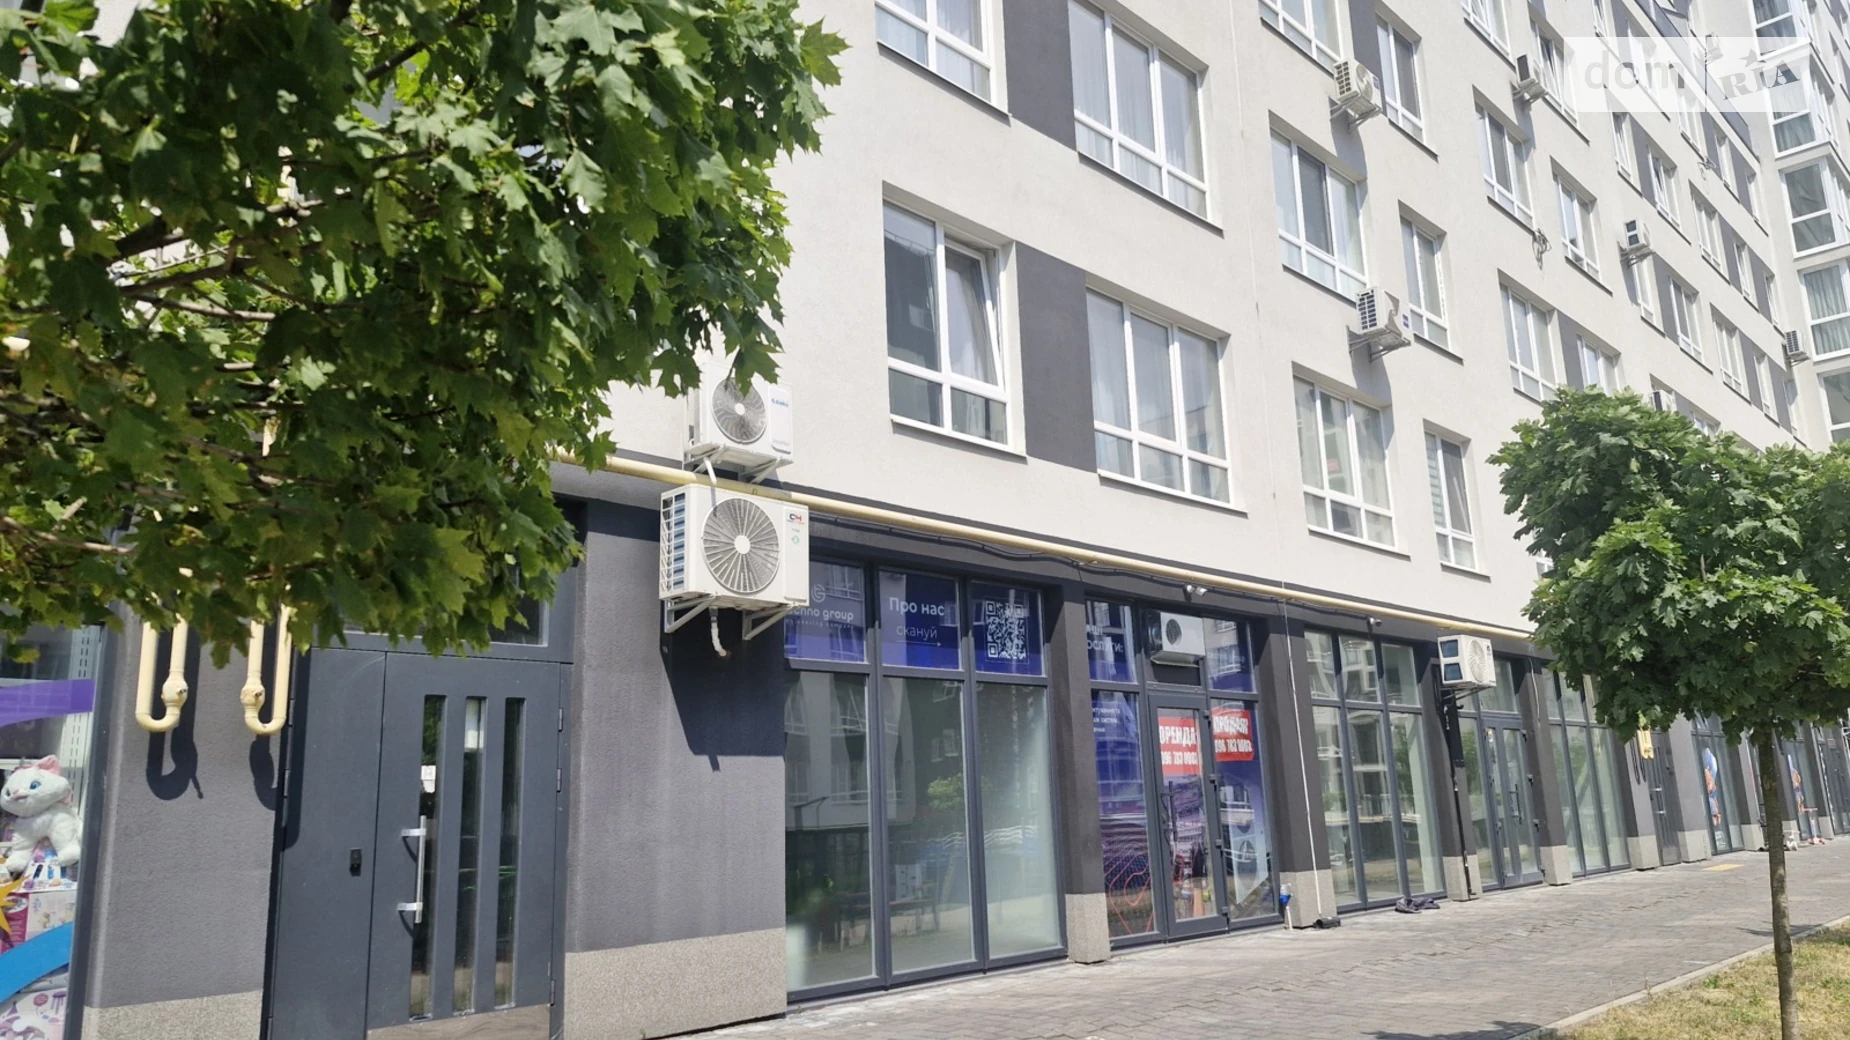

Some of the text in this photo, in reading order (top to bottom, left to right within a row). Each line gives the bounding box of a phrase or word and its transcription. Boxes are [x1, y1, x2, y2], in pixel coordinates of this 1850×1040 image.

[889, 596, 945, 616] Про нас
[822, 609, 854, 623] group
[896, 625, 938, 641] скануй
[1086, 624, 1103, 636] АШІ
[1086, 639, 1124, 653] ОСЛУГИ:
[1159, 725, 1197, 748] ОРЕНДА
